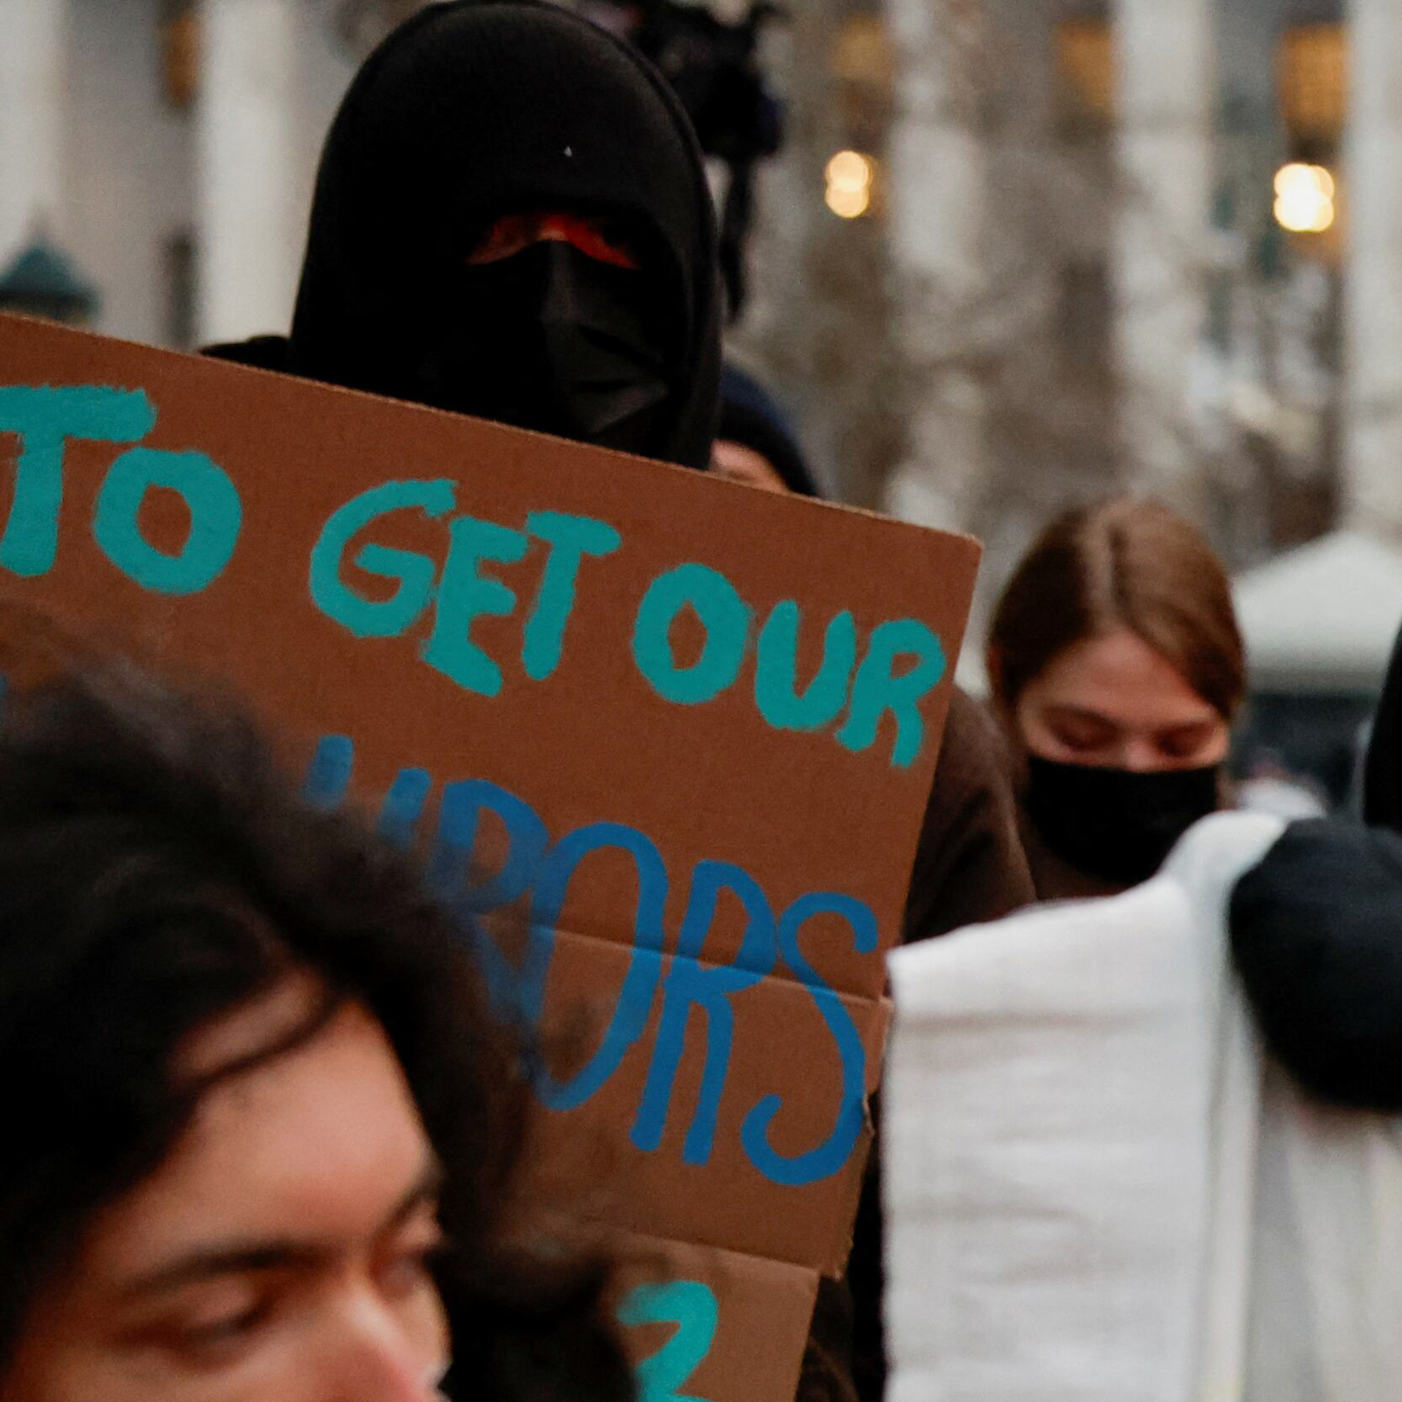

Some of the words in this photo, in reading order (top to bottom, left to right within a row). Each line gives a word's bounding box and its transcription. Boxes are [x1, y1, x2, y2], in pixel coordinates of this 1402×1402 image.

[0, 385, 242, 596] TO
[309, 479, 620, 696] GET
[631, 564, 947, 769] OUR
